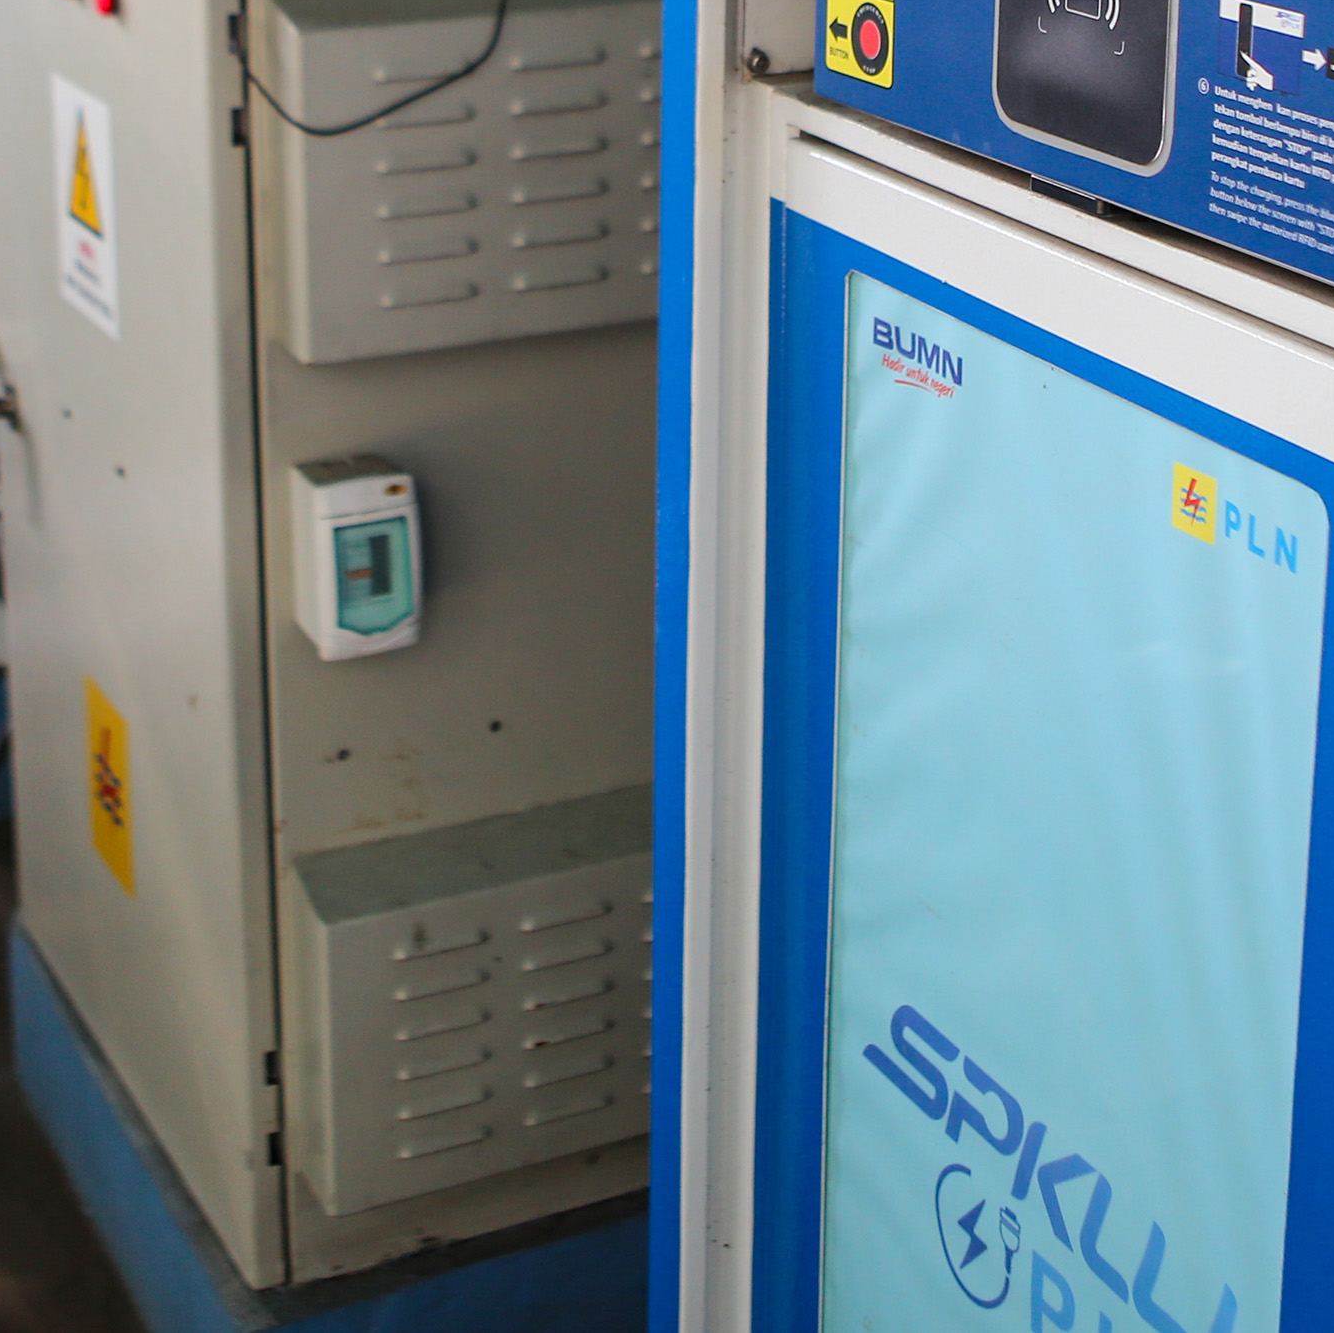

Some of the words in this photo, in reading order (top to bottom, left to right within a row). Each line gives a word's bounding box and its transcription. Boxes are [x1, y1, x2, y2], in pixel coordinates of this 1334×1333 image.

[1215, 85, 1236, 101] Untuk
[1214, 103, 1235, 117] tekan
[1236, 110, 1263, 126] tombol
[1213, 119, 1240, 135] dengan
[1211, 170, 1219, 182] To
[1220, 176, 1235, 189] stop
[1237, 179, 1249, 192] the
[1210, 187, 1234, 204] button
[1235, 195, 1257, 211] below
[1258, 203, 1271, 216] the
[1209, 203, 1226, 216] then
[1227, 210, 1248, 224] swipe
[1248, 216, 1261, 229] the
[873, 316, 962, 386] BUMN
[882, 354, 905, 373] Hadir
[1224, 500, 1298, 574] PLN
[863, 1004, 1238, 1333] SPKLU
